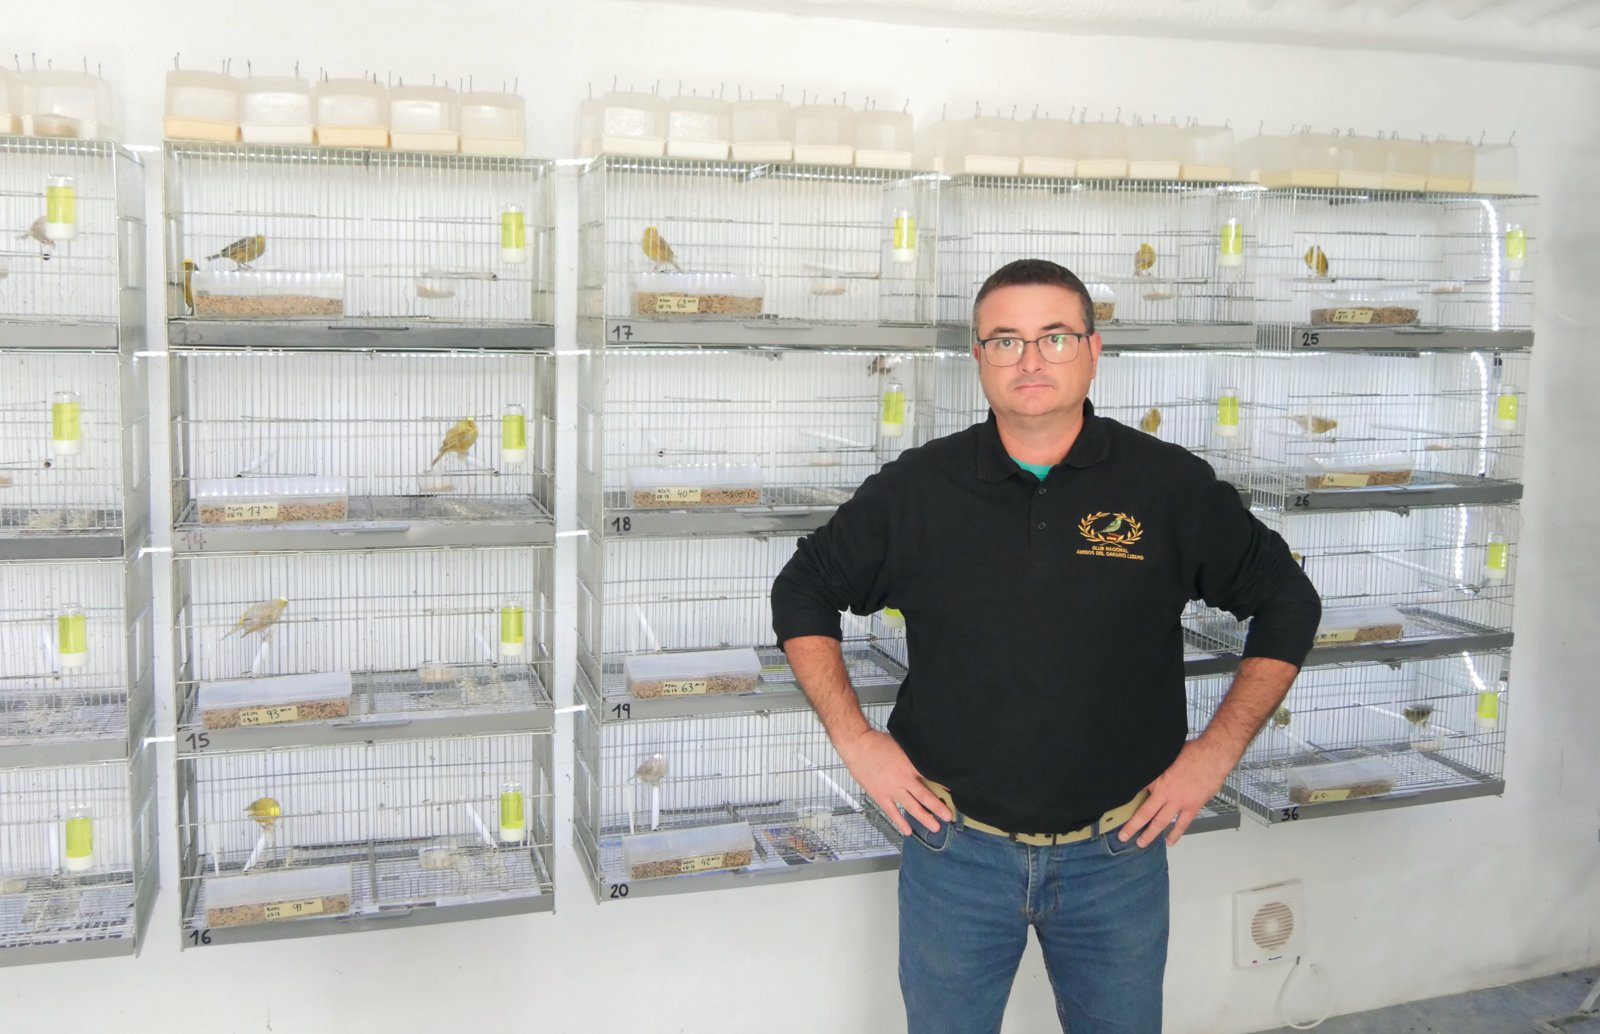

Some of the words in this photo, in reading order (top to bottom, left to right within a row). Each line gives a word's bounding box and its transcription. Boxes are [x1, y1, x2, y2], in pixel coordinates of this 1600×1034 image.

[612, 325, 634, 340] 17
[1302, 332, 1320, 347] 25
[677, 489, 688, 499] 40
[1294, 493, 1311, 507] 26
[247, 505, 261, 517] 17
[611, 516, 632, 532] 18
[681, 682, 694, 693] 63
[266, 708, 280, 720] 93
[611, 703, 631, 719] 19
[185, 732, 210, 750] 15
[1281, 806, 1300, 822] 36
[610, 883, 629, 899] 20
[189, 928, 212, 946] 16
